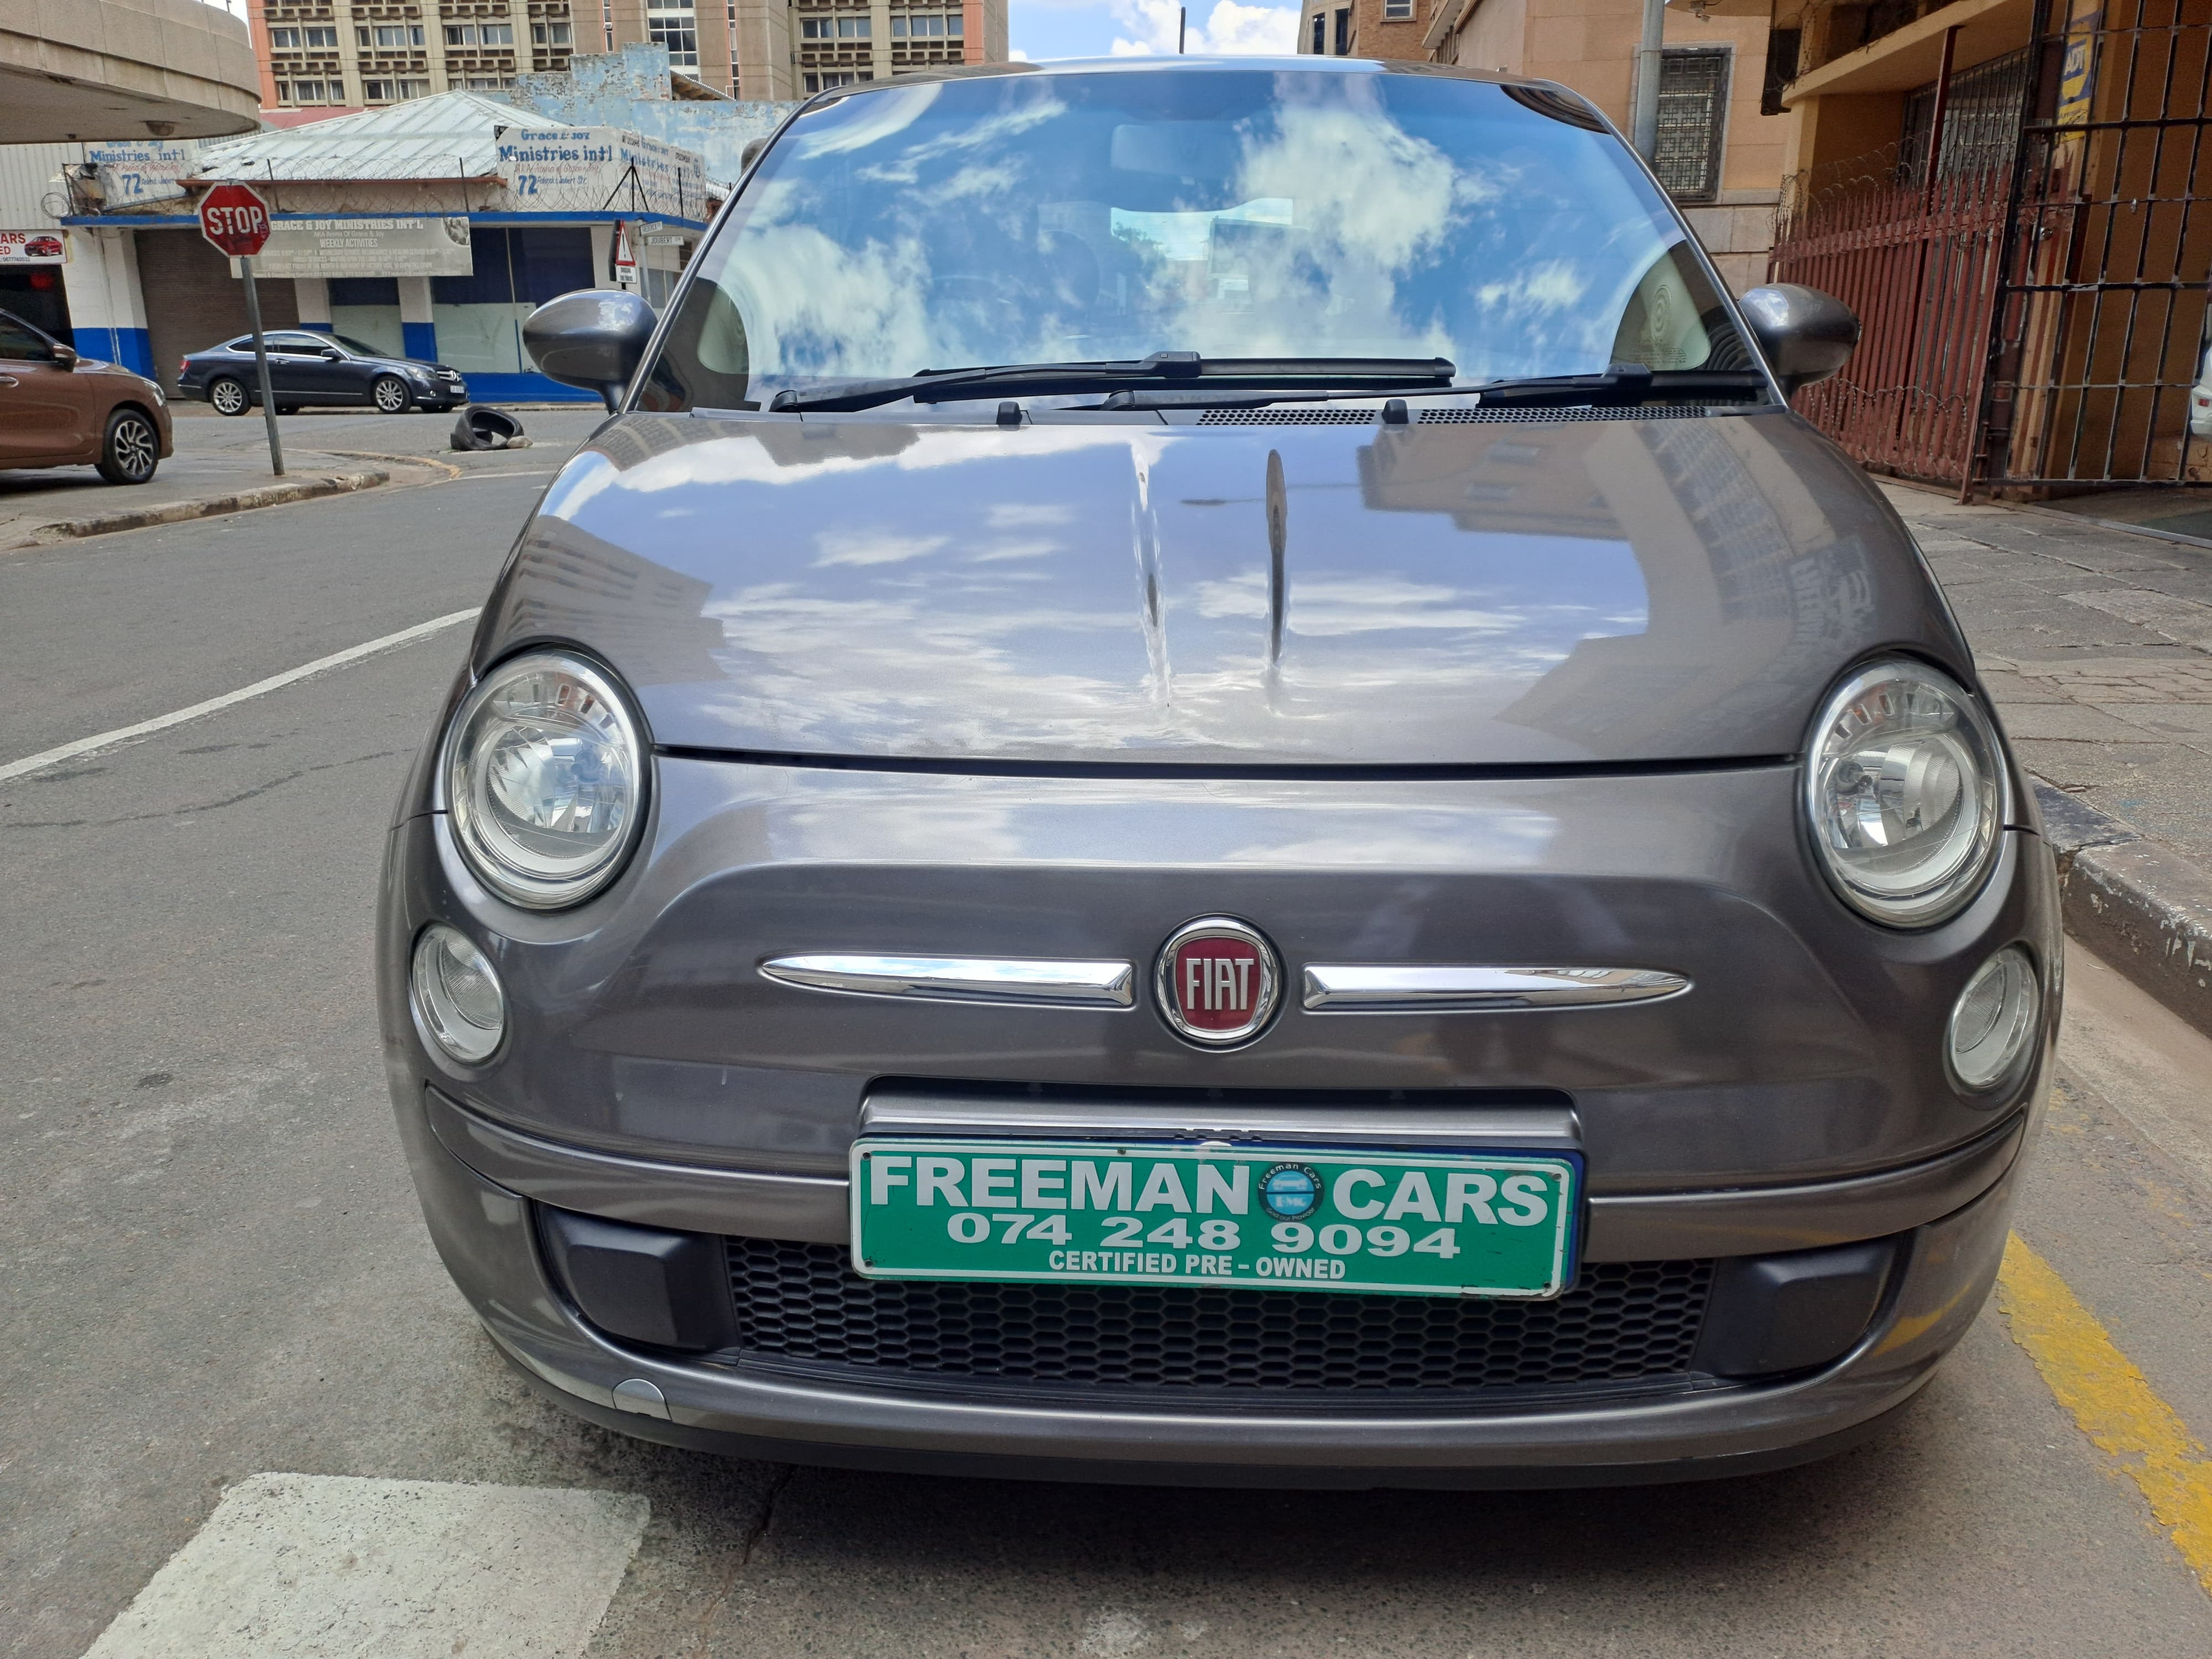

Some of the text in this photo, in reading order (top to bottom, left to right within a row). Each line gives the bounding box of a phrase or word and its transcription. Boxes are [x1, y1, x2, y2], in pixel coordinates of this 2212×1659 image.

[2064, 45, 2085, 75] ADT
[521, 129, 557, 140] Grace
[89, 150, 150, 163] Ministries
[498, 145, 579, 161] Ministries
[122, 173, 143, 195] 72
[518, 175, 538, 195] 72
[207, 206, 263, 235] STOP
[271, 220, 424, 231] GRACE & JOY MINISTRIES INT'L
[320, 238, 379, 248] WEEKLY ACTIVITIES
[1186, 958, 1254, 1010] FIAT
[1259, 1164, 1321, 1190] Freeman Cars
[870, 1156, 1547, 1227] FREEMAN CARS
[947, 1213, 1460, 1259] 074 248 9094
[1049, 1250, 1177, 1272] CERTIFIED
[1186, 1254, 1232, 1275] PRE
[1256, 1256, 1345, 1279] OWNED
